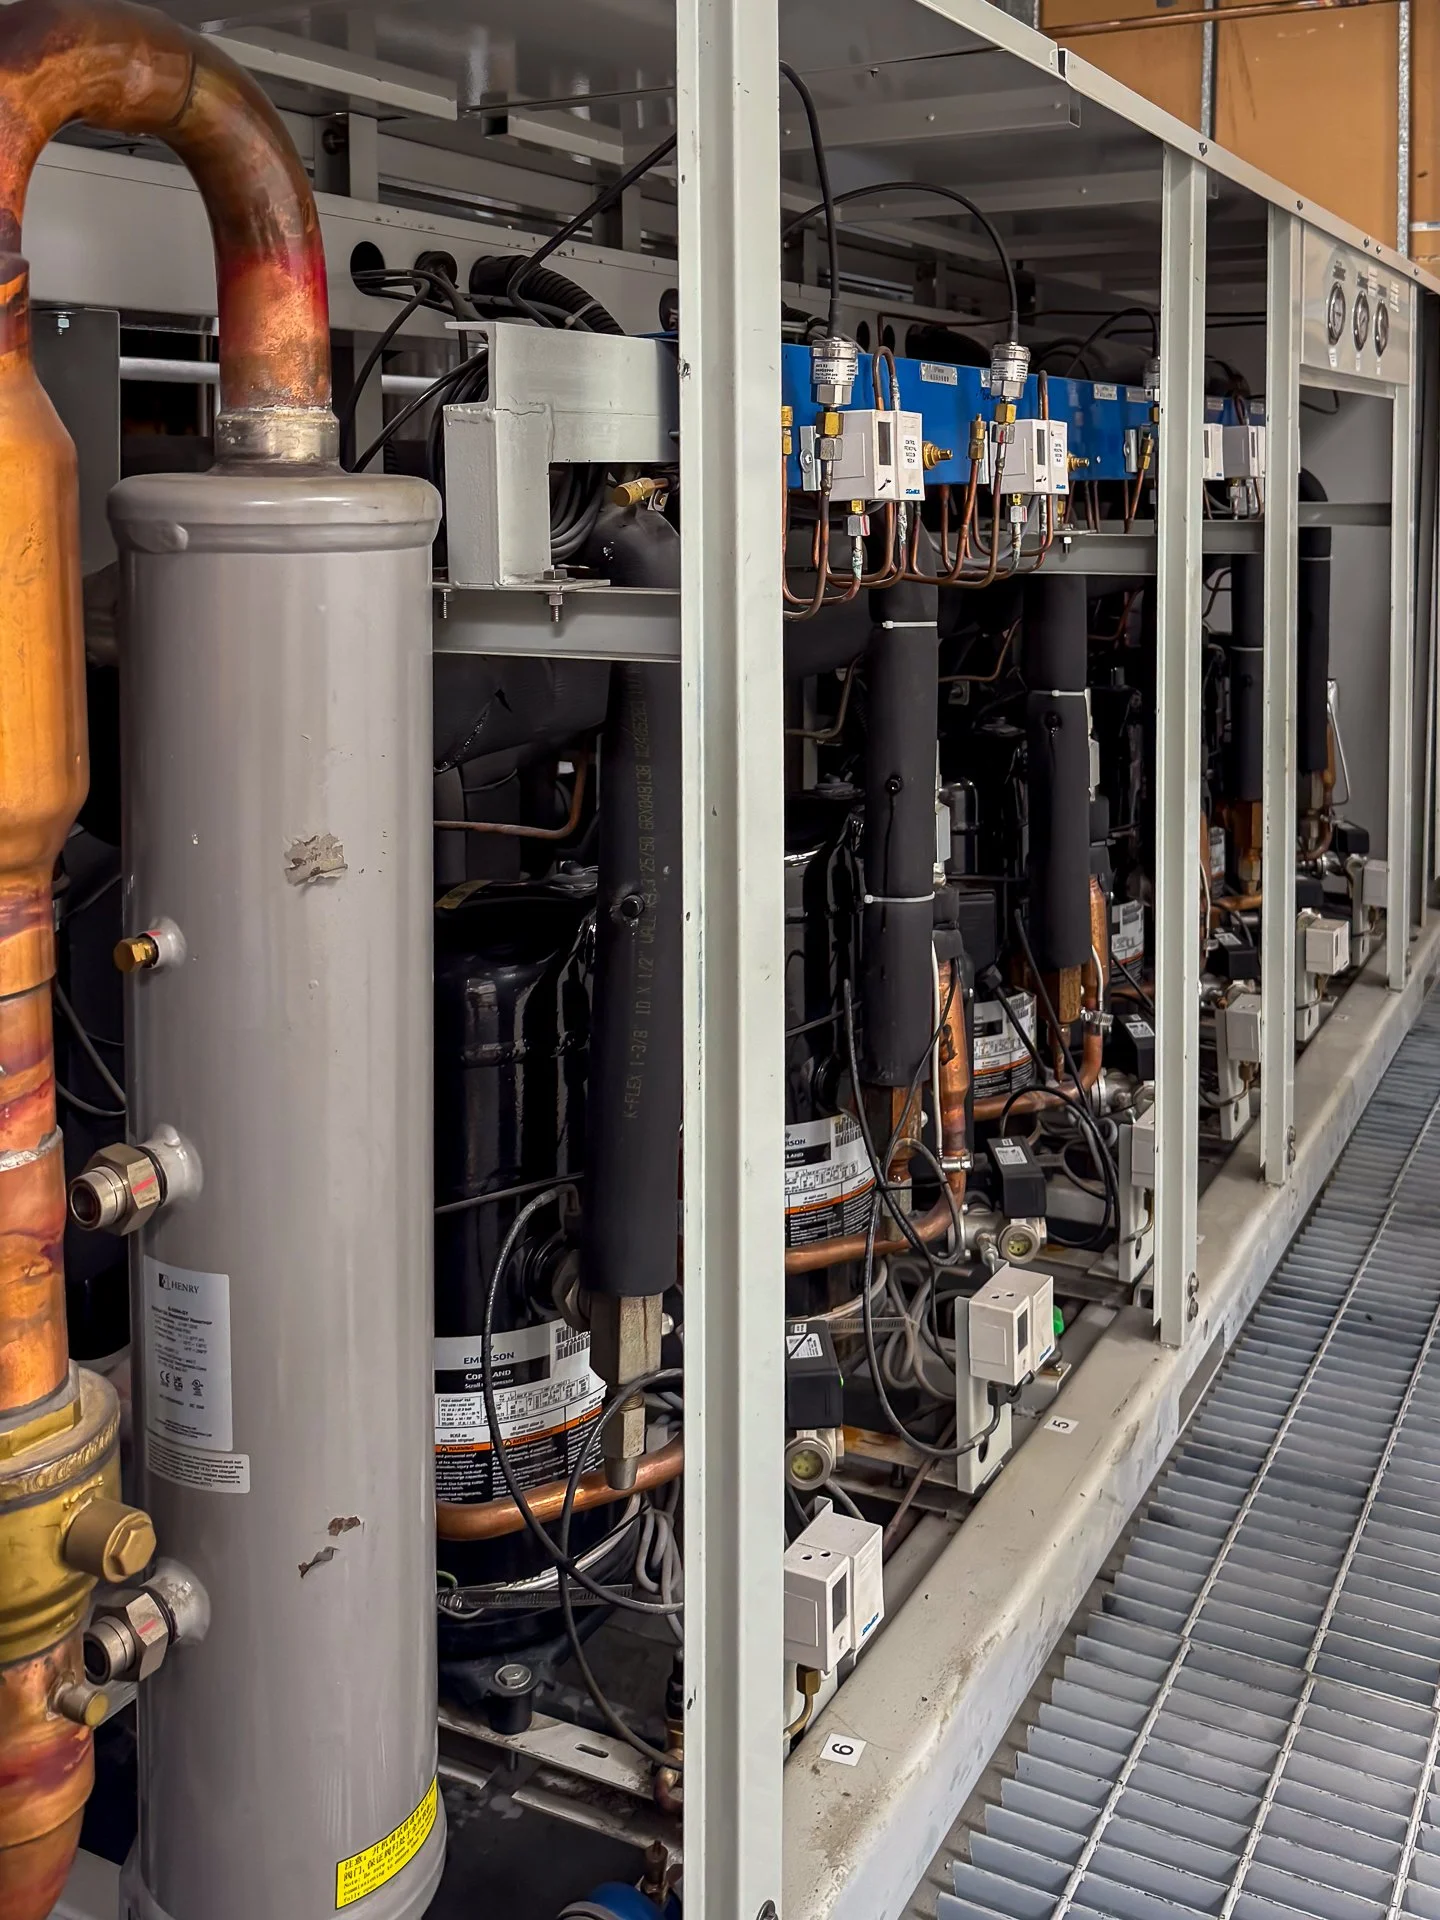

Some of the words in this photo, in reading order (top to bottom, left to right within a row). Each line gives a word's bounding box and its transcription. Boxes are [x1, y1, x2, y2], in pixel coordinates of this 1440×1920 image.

[639, 836, 655, 872] 25/50
[640, 915, 657, 944] WALL
[637, 985, 651, 994] X
[623, 1073, 643, 1119] K-FLEX
[171, 1280, 200, 1294] HENRY
[464, 1352, 514, 1364] EMSON
[1052, 1420, 1070, 1429] 5
[831, 1743, 854, 1756] 6
